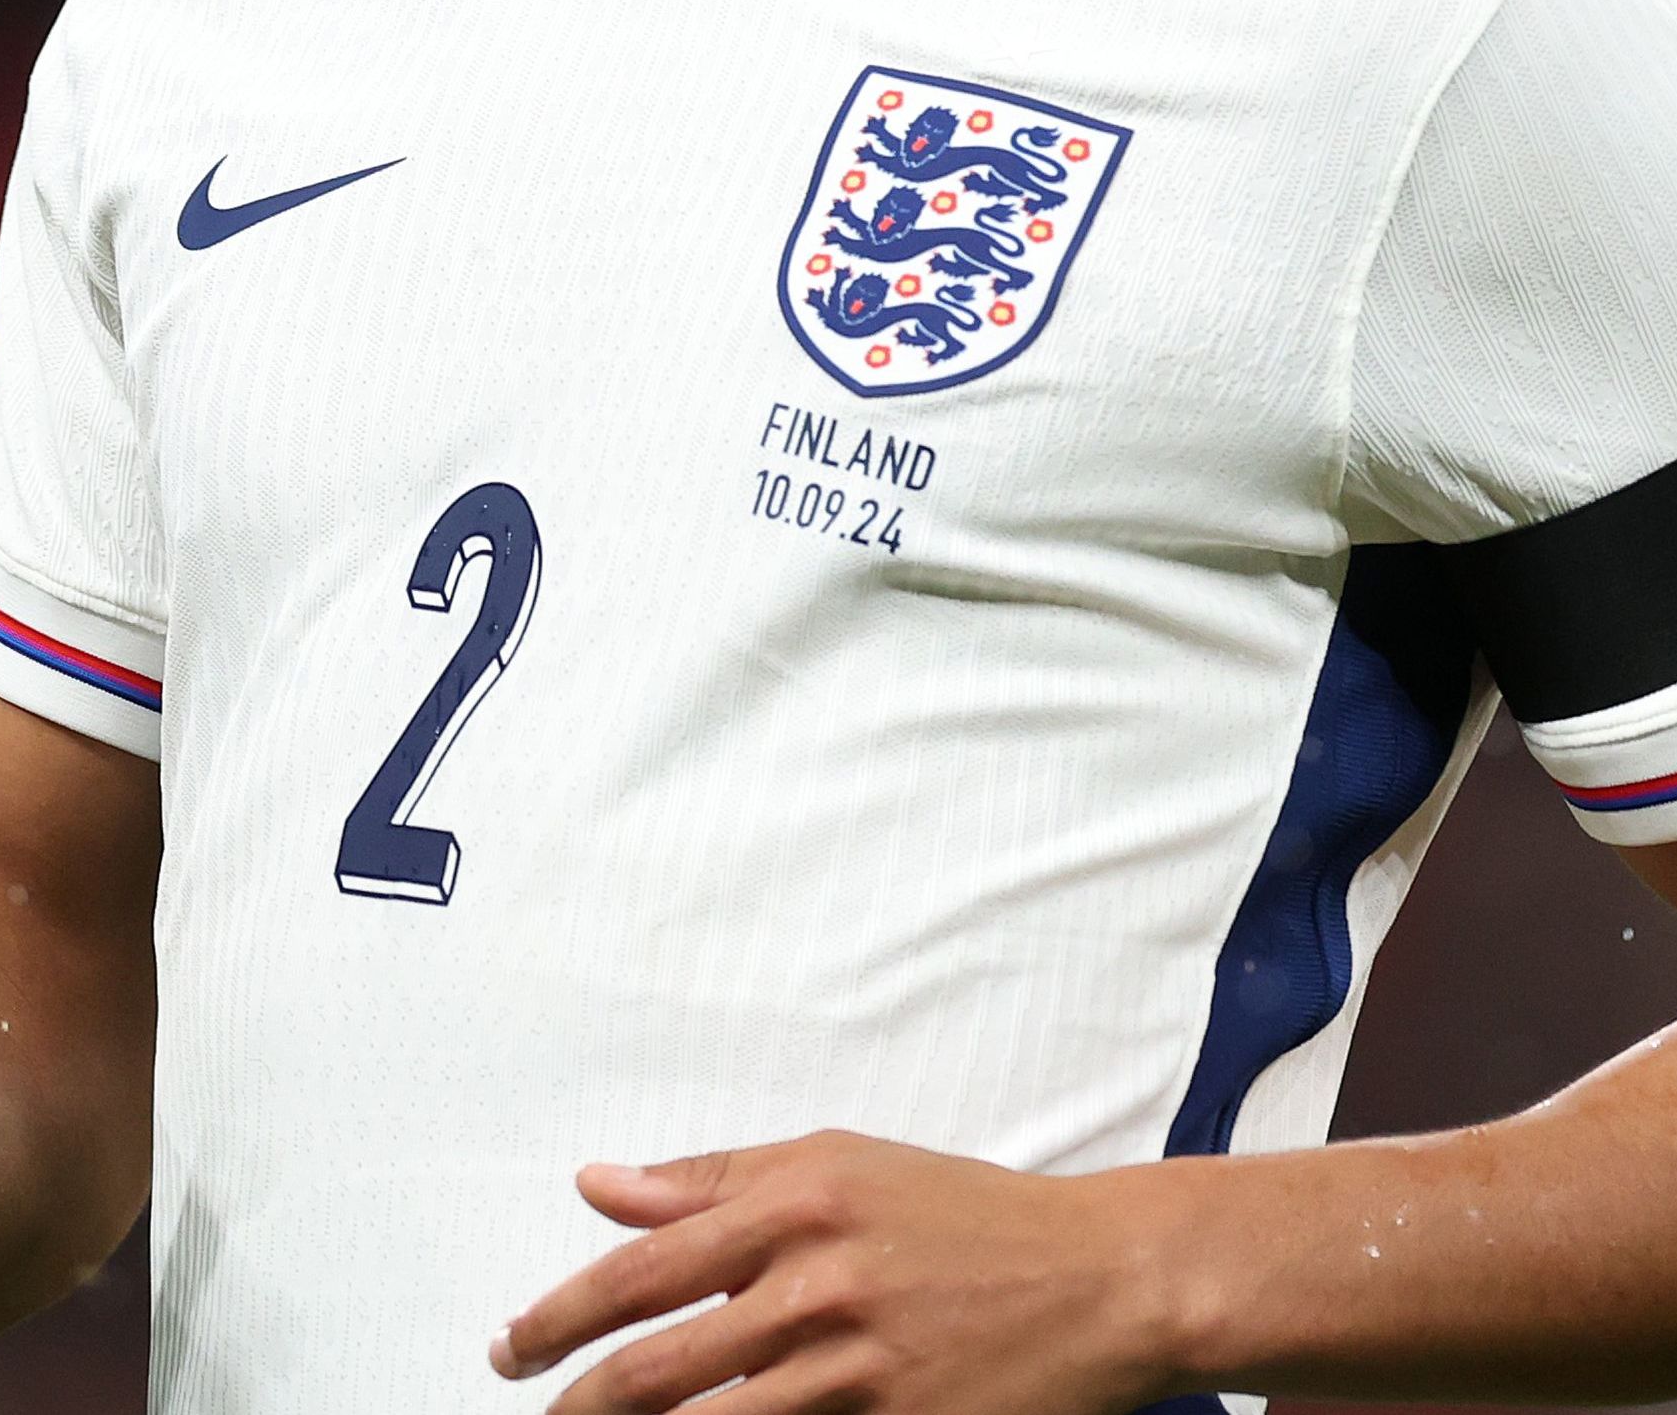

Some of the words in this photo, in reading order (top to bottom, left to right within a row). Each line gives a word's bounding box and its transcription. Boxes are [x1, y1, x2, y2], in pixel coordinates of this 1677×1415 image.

[761, 403, 937, 492] FINLAND
[752, 469, 905, 554] 10.09.24
[335, 482, 542, 905] 2
